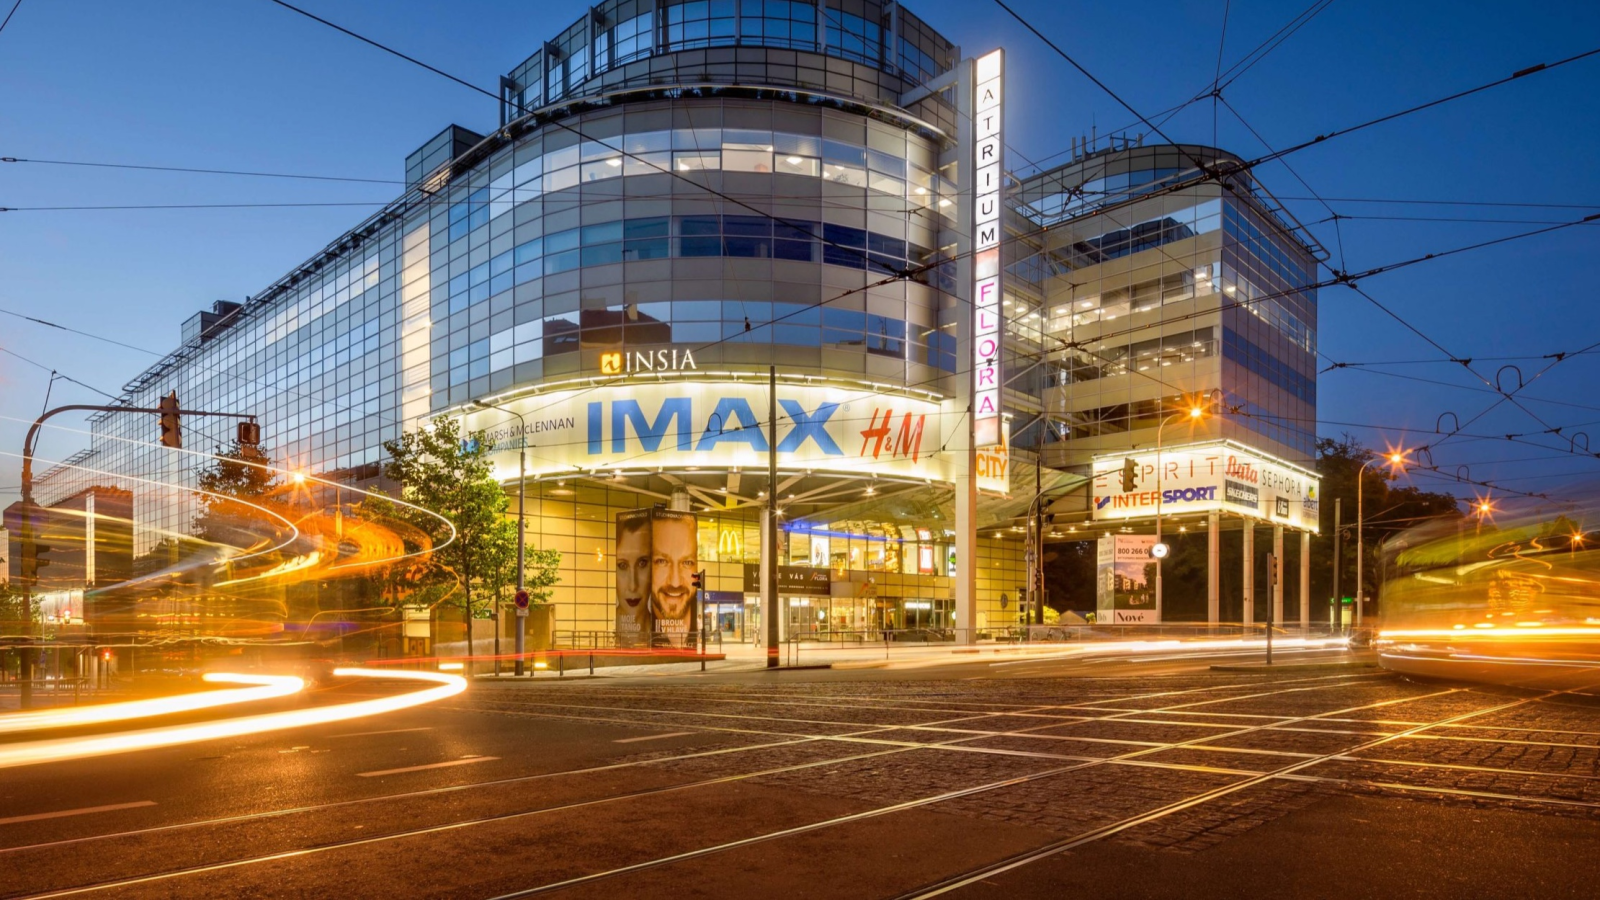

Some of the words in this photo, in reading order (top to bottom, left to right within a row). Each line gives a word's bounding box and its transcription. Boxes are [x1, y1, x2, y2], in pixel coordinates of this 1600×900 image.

[980, 88, 995, 245] ATRIUM
[626, 349, 697, 372] INSIA
[978, 281, 996, 416] FLORA
[485, 428, 509, 443] MARSH
[516, 417, 575, 437] McLENNAN
[587, 397, 844, 456] IMAX
[860, 407, 925, 464] H&M
[976, 453, 1008, 481] CITY
[1226, 488, 1258, 504] SKECHERS
[1262, 469, 1302, 498] SEPHORA
[1113, 486, 1217, 508] INTERSPORT
[1118, 547, 1129, 555] 800
[1132, 547, 1143, 555] 266
[661, 619, 684, 627] BROUK
[1117, 612, 1144, 622] Nové
